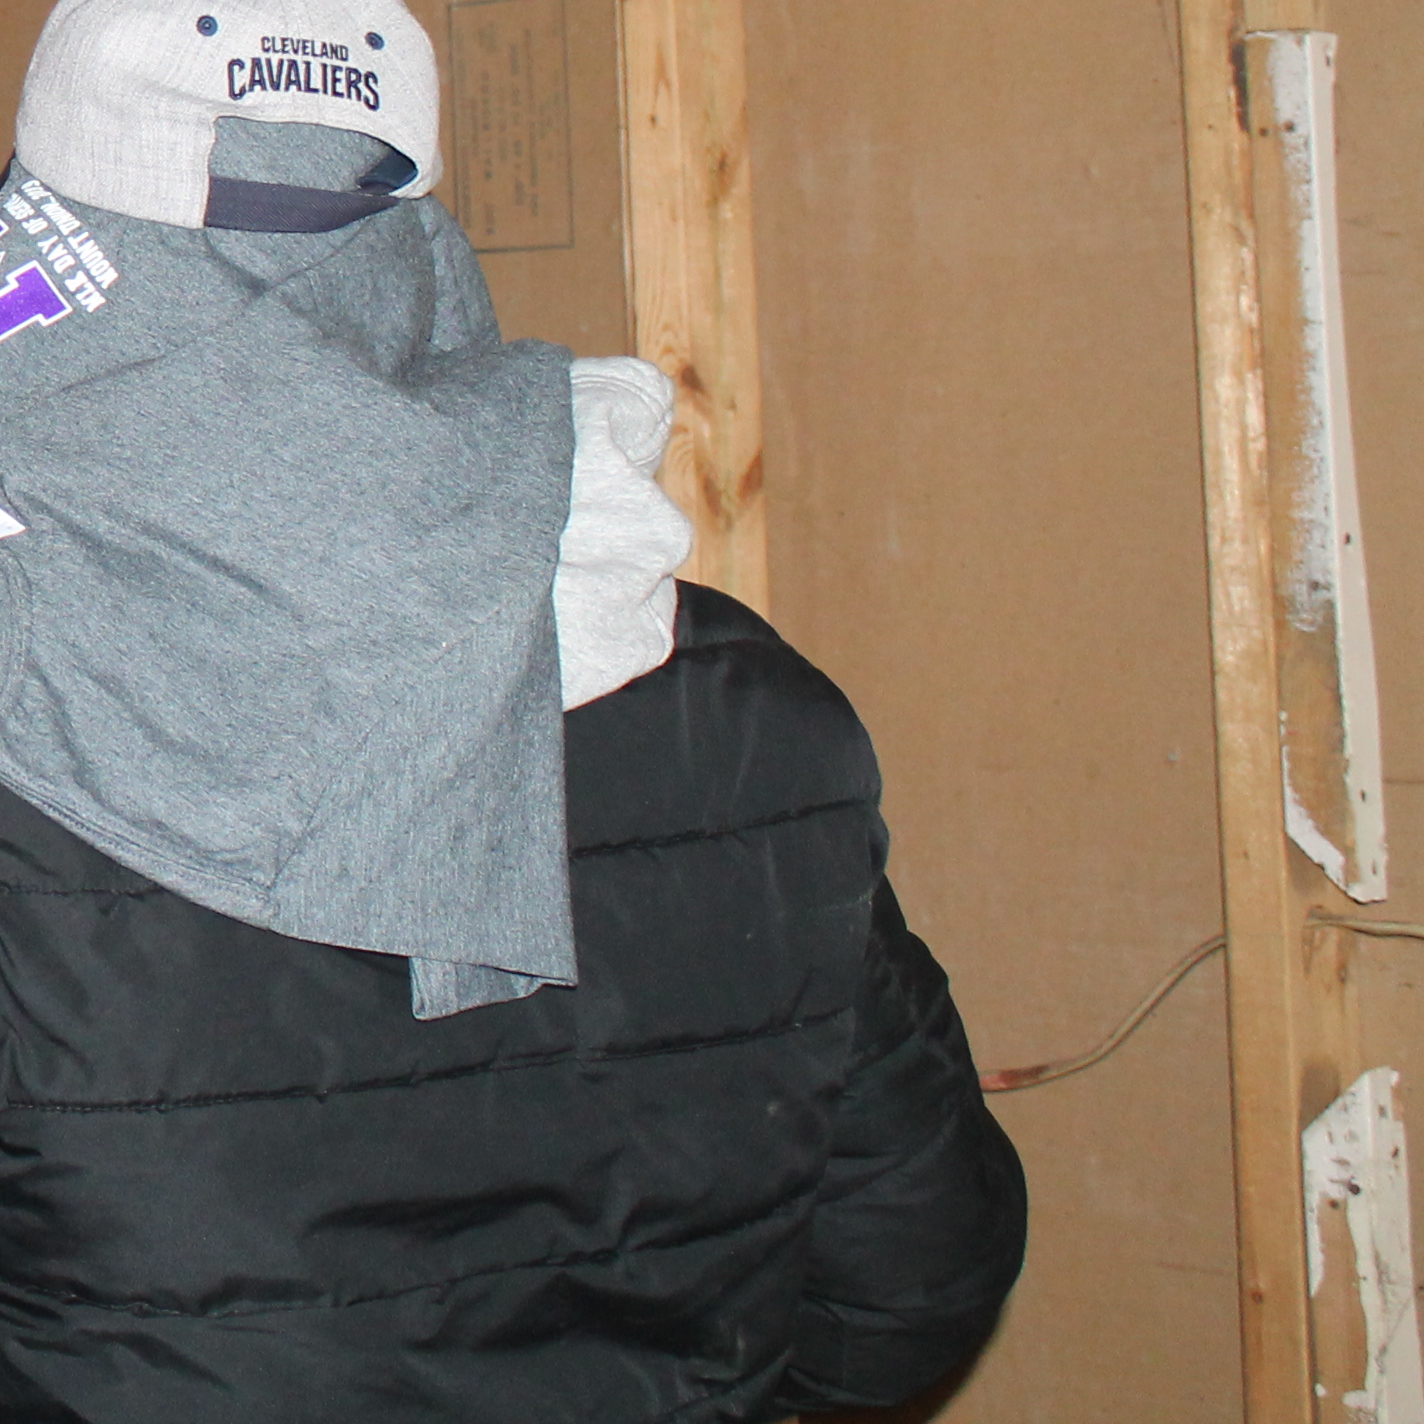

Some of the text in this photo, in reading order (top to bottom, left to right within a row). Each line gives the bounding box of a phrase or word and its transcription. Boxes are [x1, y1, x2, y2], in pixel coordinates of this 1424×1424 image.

[260, 36, 349, 62] CLEVELAND
[227, 57, 380, 111] CAVALIERS
[21, 216, 48, 236] OF
[37, 235, 77, 274] DAY
[67, 230, 119, 290] MOUNT
[64, 270, 107, 313] MLK
